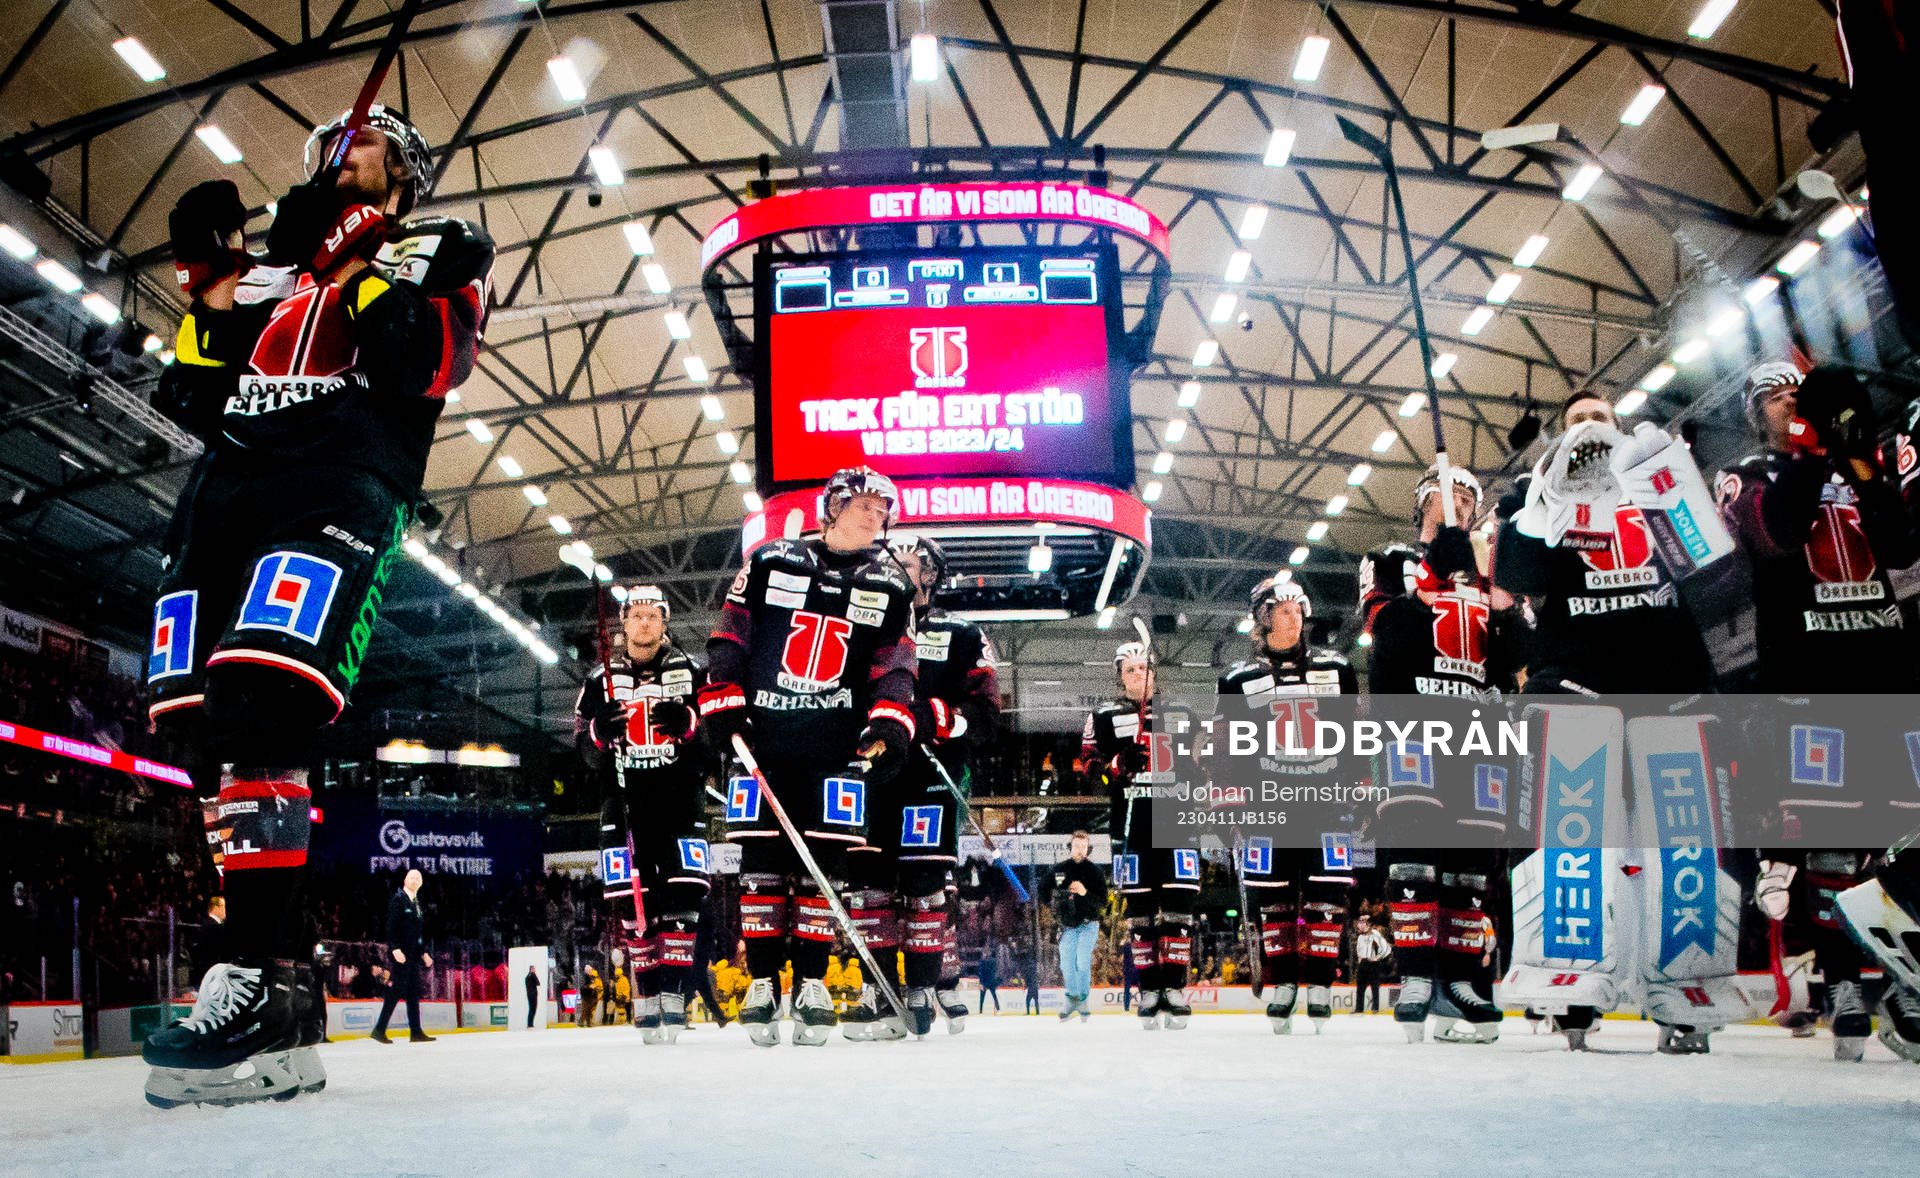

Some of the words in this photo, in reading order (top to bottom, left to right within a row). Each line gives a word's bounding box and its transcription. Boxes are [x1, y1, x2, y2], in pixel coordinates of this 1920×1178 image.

[870, 192, 916, 218] DET
[919, 187, 953, 216] ÄR
[956, 190, 980, 215] VI
[983, 189, 1037, 215] SOM
[1041, 186, 1073, 215] ÄR
[1076, 188, 1150, 236] ÖREBRO
[799, 397, 880, 432] TACK
[882, 390, 939, 428] FÖR
[943, 393, 1001, 426] ERT
[1004, 387, 1084, 424] STÖD
[860, 431, 884, 455] VI
[886, 430, 927, 454] SES
[929, 427, 1024, 453] 2023/24
[902, 488, 927, 516] VI
[930, 486, 987, 515] SOM
[990, 481, 1023, 514] ÄR
[1027, 482, 1114, 523] ÖREBRO
[1591, 571, 1652, 587] ÖREBRO
[1820, 583, 1880, 599] ÖREBRO
[1803, 609, 1885, 632] BEHRN
[380, 820, 484, 854] Gustavsvik
[1660, 767, 1704, 936] HEROK
[1555, 777, 1595, 946] HEROK
